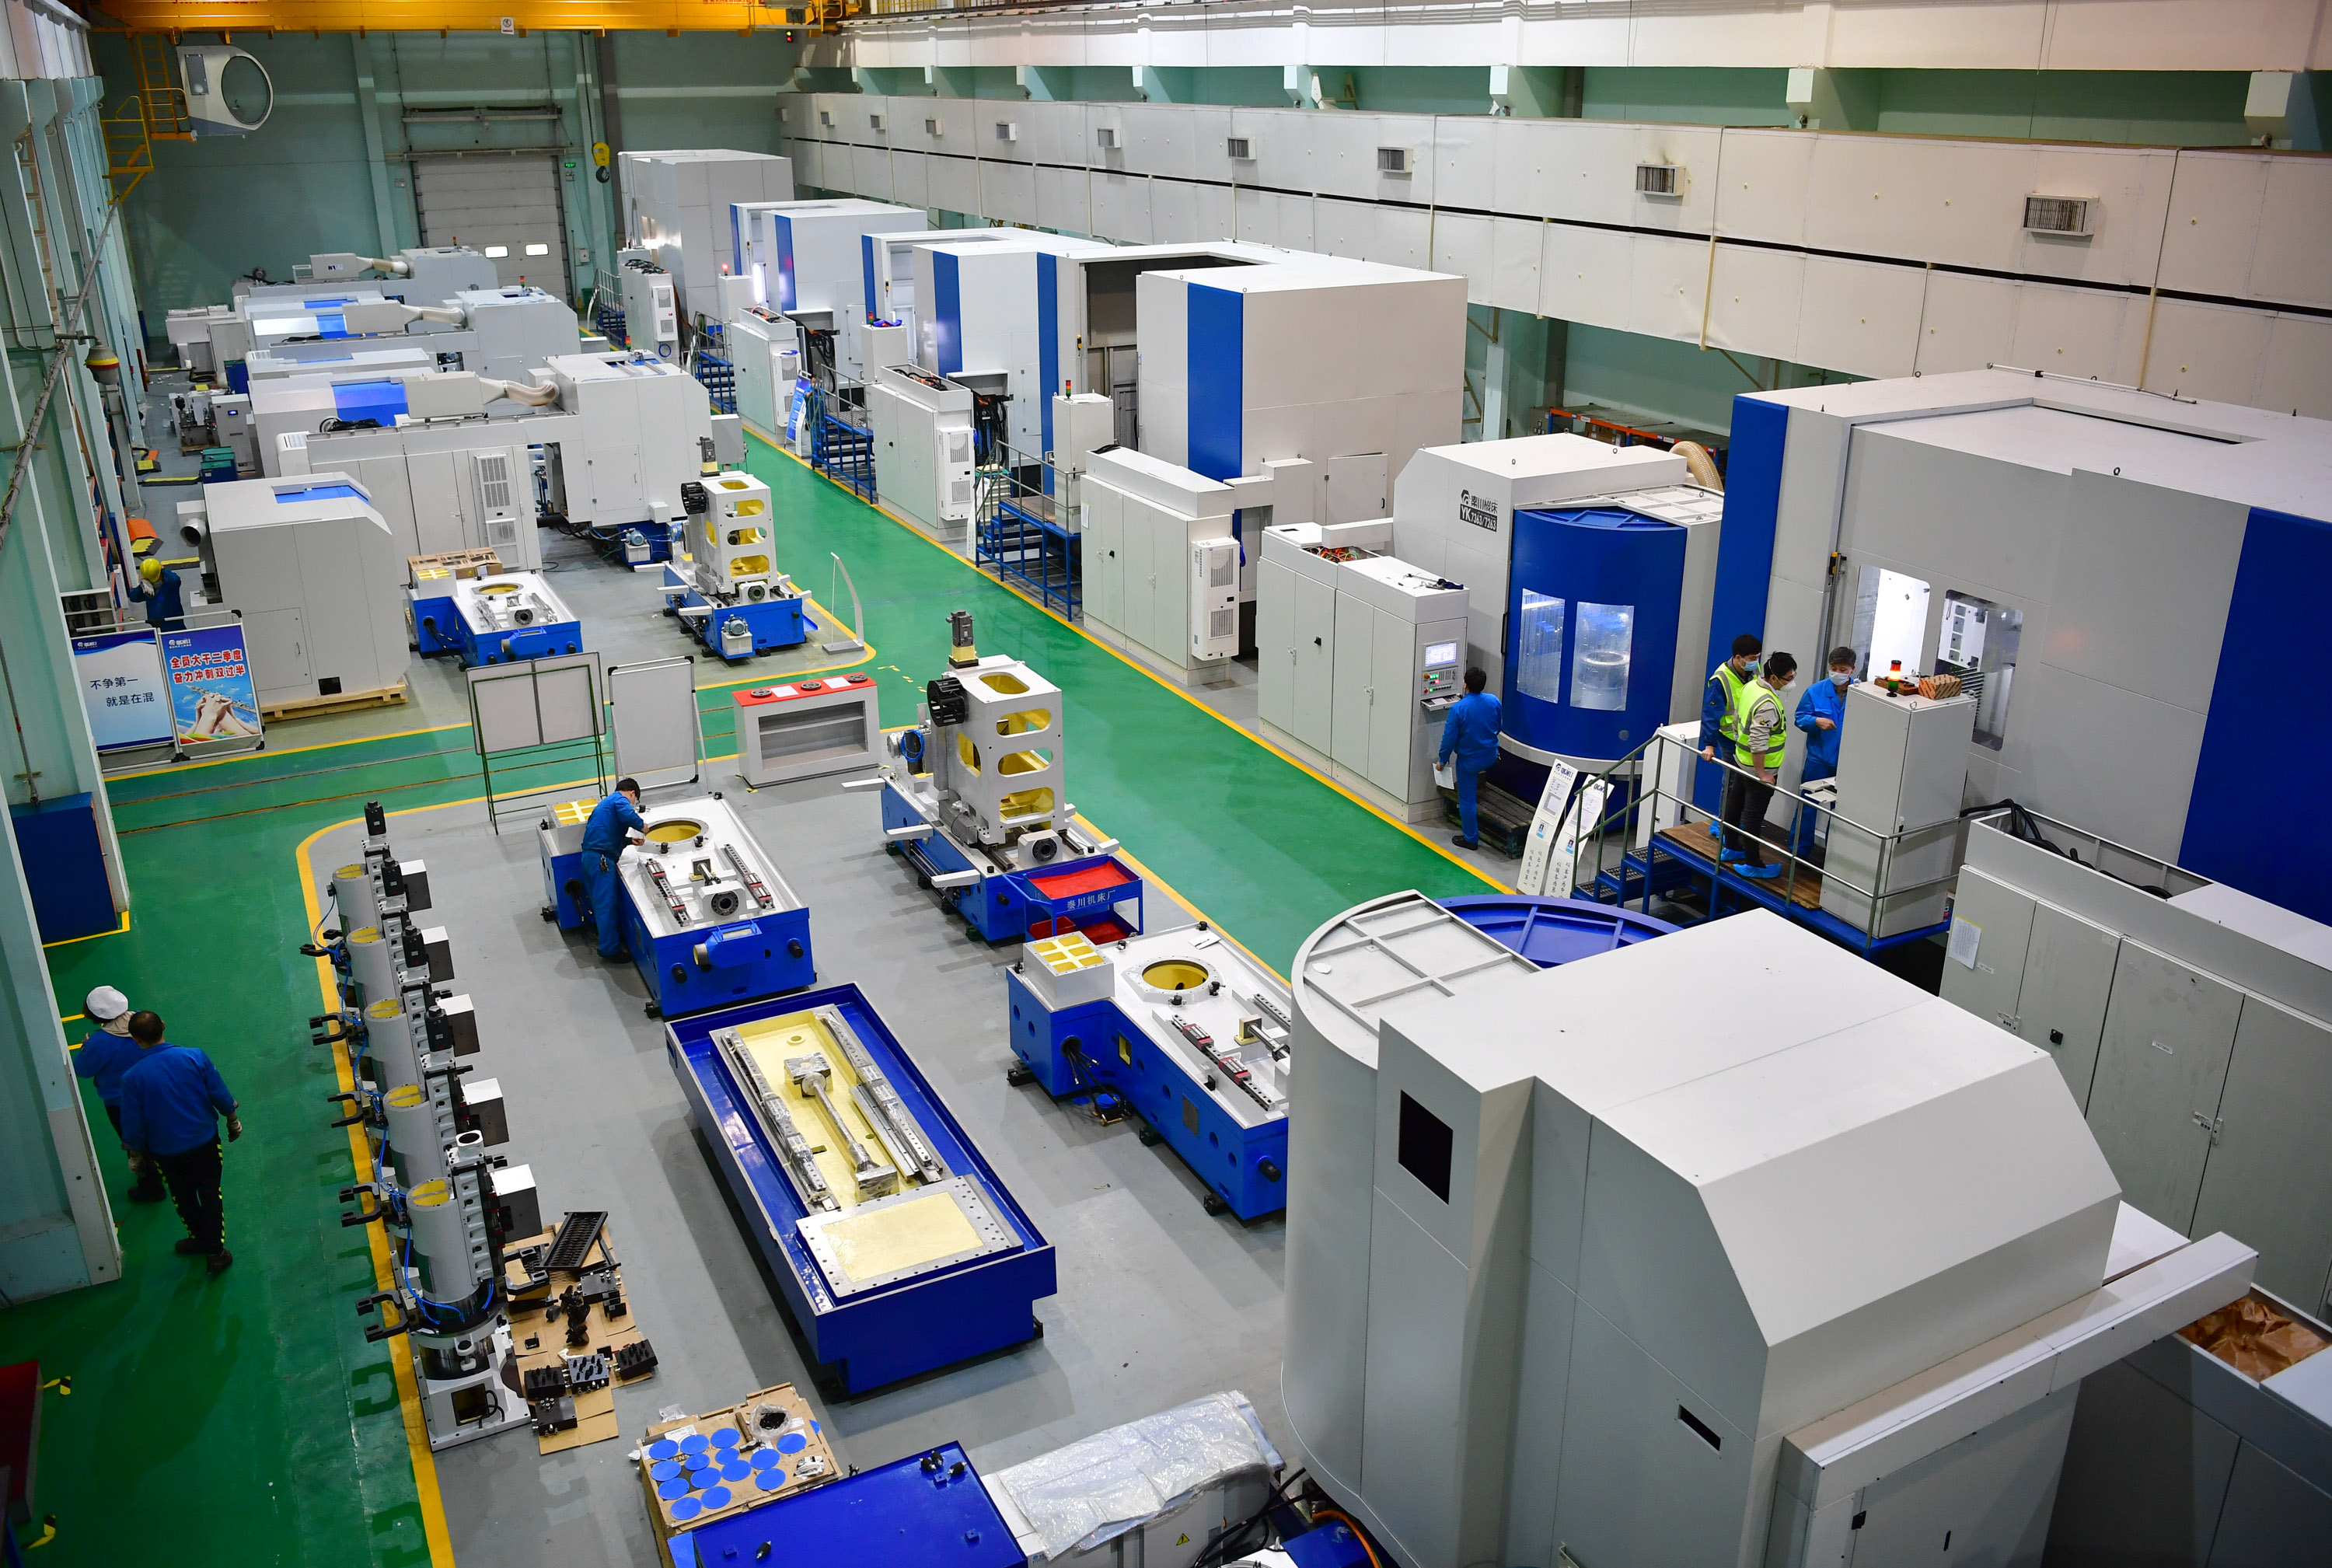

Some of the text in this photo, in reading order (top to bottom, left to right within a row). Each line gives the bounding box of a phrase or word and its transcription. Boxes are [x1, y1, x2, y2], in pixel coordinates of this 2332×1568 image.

[170, 648, 243, 669] 全员大干二季度
[89, 676, 138, 690] 不争第一
[173, 664, 246, 684] 奋力冲刺双过半
[106, 691, 155, 707] 就是在混
[1067, 889, 1115, 910] 秦川机床厂
